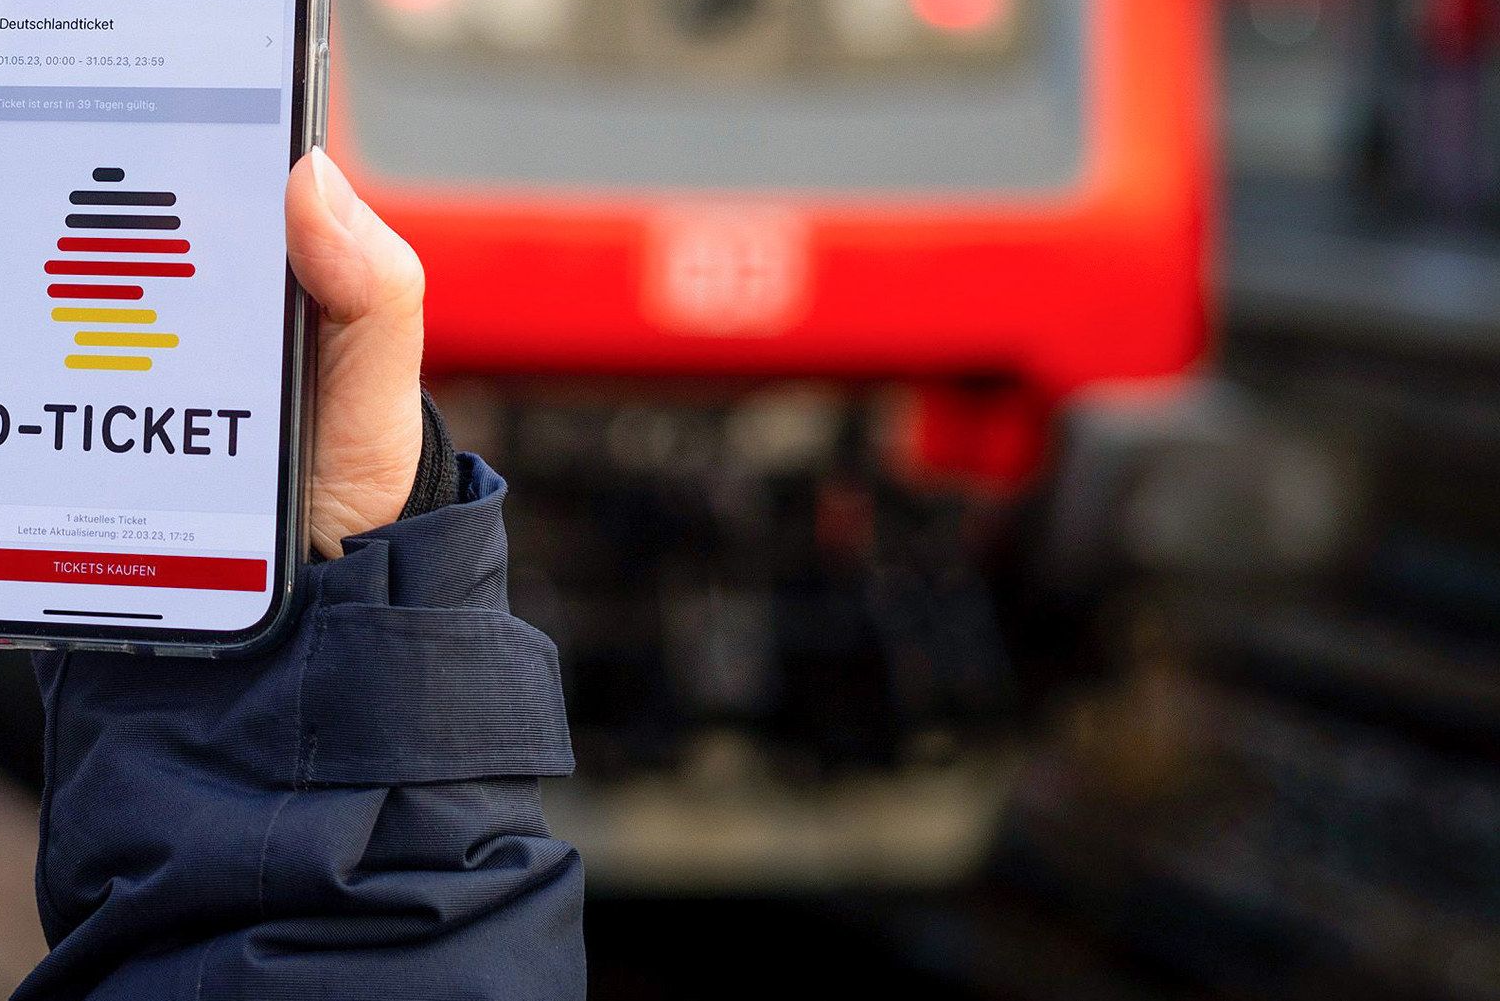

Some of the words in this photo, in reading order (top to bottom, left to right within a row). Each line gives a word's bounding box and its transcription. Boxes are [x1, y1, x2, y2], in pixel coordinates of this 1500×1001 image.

[0, 17, 115, 31] Deutschlandticket
[45, 56, 76, 66] 00:00
[86, 56, 131, 68] 31.05.23,
[134, 56, 165, 67] 23:59
[28, 98, 41, 109] ist
[43, 99, 63, 109] erst
[65, 98, 75, 109] in
[77, 99, 91, 110] 39
[94, 100, 124, 112] Tagen
[126, 99, 158, 113] gültig.
[73, 514, 115, 524] aktuelles
[119, 515, 147, 525] Ticket
[17, 526, 47, 536] Letzte
[49, 527, 119, 540] Aktualisierung:
[122, 530, 166, 541] 22.03.23,
[169, 532, 195, 542] 17:25
[53, 561, 103, 575] TICKETS
[107, 563, 156, 577] KAUFEN
